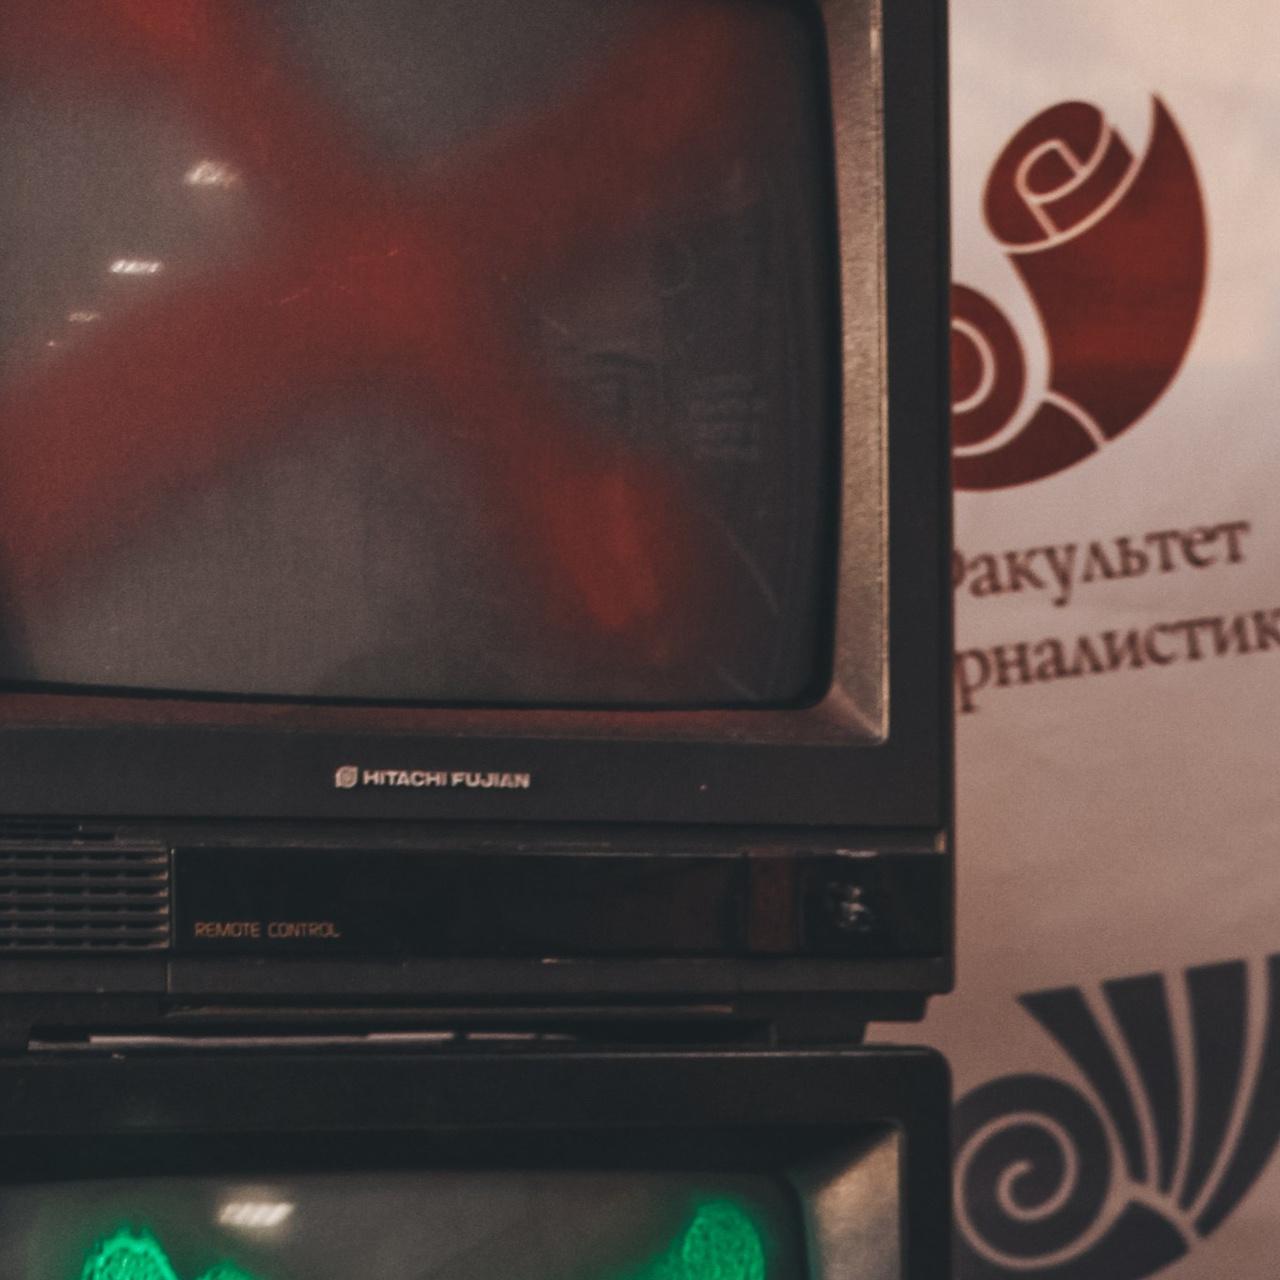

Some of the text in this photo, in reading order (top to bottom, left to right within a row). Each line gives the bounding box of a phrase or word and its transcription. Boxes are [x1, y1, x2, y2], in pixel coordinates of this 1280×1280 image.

[953, 519, 1251, 607] акультет
[363, 769, 530, 789] HITACHI FUJIAN
[194, 921, 342, 938] REMOTE CONTROL
